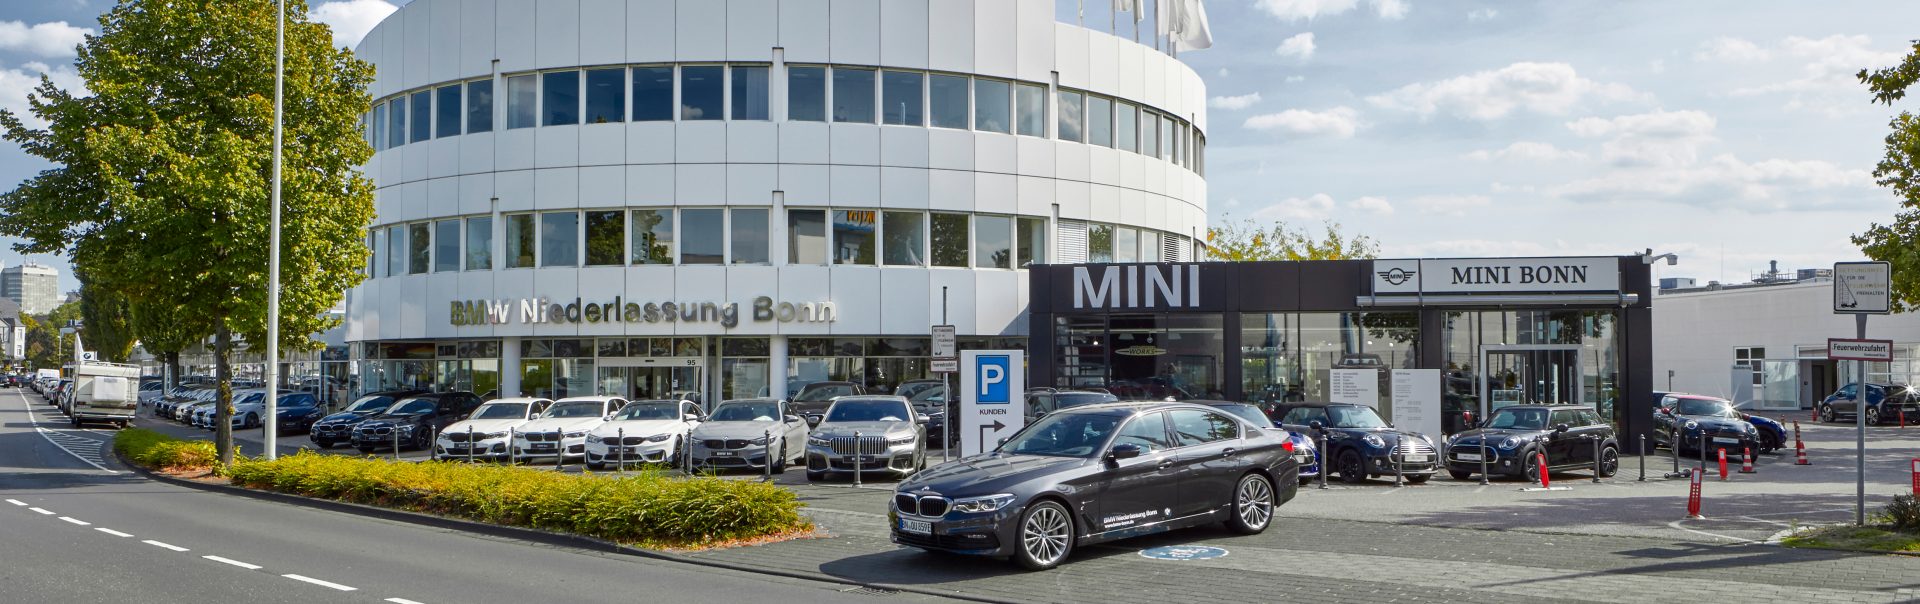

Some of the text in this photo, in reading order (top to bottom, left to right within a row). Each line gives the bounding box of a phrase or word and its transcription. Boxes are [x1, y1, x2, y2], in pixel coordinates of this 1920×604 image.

[1074, 265, 1200, 308] MINI
[1451, 266, 1588, 285] MINI BONN
[450, 295, 837, 328] BMW Niederlassung Bonn
[1833, 343, 1886, 352] Feuerwehrzufahrt
[981, 364, 1005, 396] P
